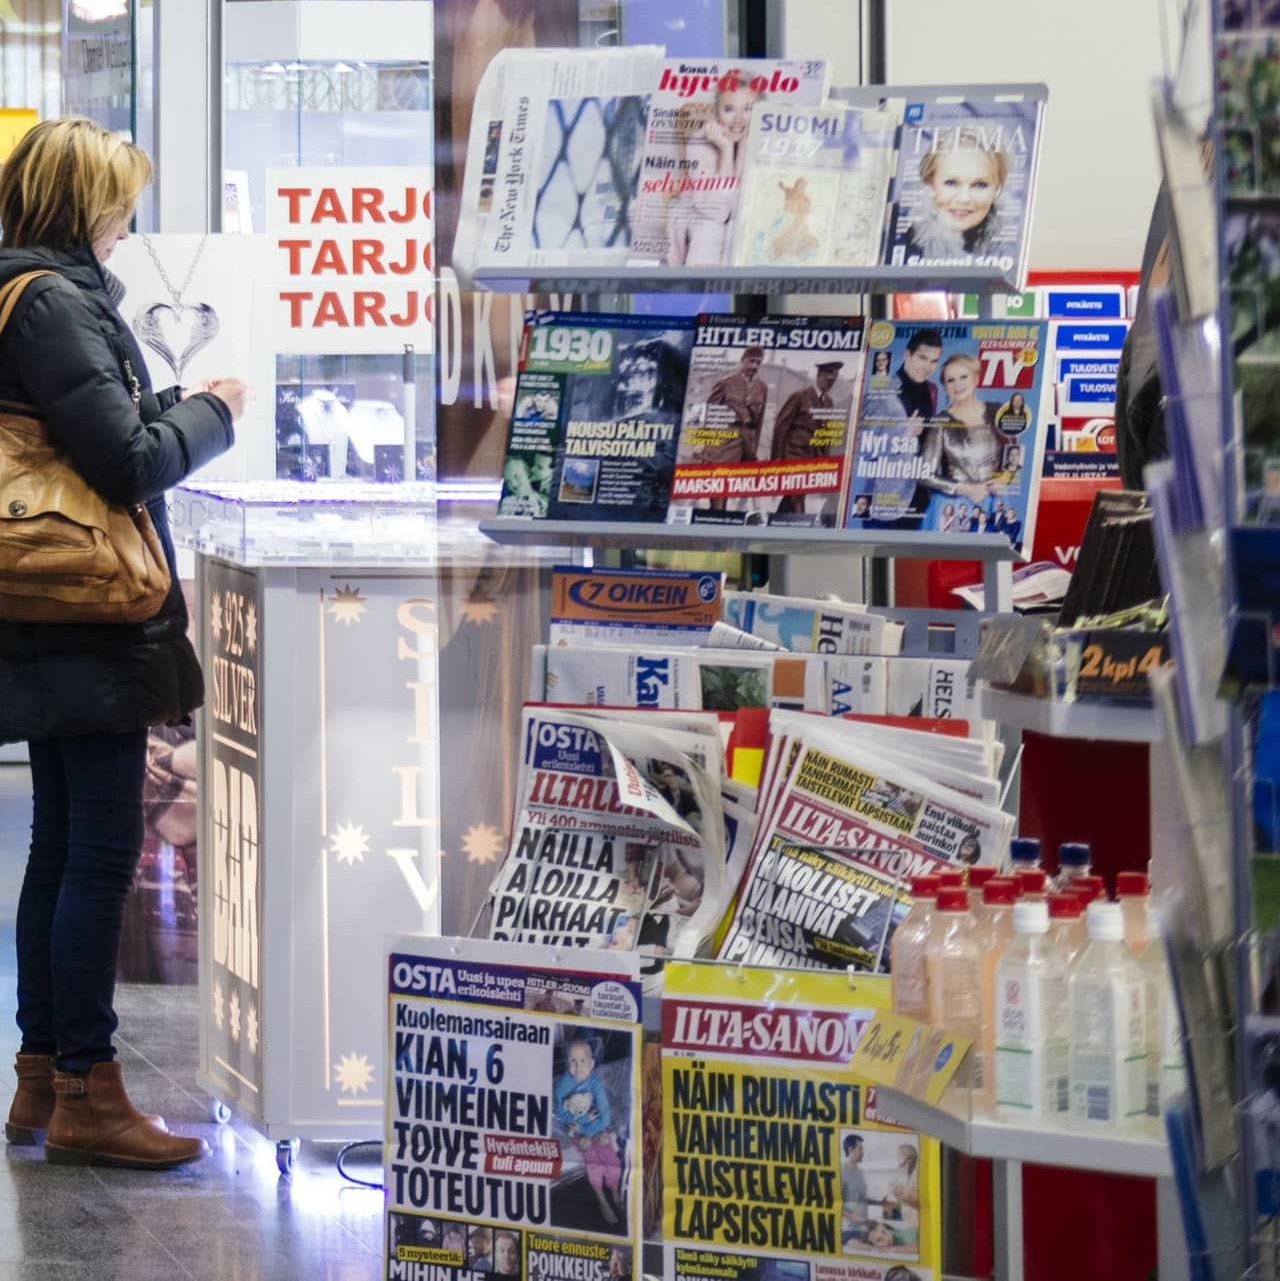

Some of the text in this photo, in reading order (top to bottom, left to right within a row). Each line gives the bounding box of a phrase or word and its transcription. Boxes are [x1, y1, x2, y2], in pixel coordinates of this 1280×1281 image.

[659, 67, 800, 98] hyvä olo
[760, 112, 838, 137] SUOMI
[494, 221, 516, 253] The
[509, 96, 531, 144] Times
[645, 155, 675, 169] Näin
[278, 188, 433, 224] TARJ
[278, 238, 433, 276] TARJ
[279, 291, 433, 328] TARJ
[530, 327, 614, 362] 1930
[695, 326, 775, 347] HITLER
[788, 329, 861, 350] SUOMI
[980, 350, 1028, 387] TV
[1079, 383, 1117, 393] TULOSV
[566, 420, 617, 441] NOUSU
[618, 421, 674, 441] PÄÄTTYI
[860, 431, 919, 457] Nyt saa
[1097, 435, 1116, 445] LOT
[565, 438, 656, 458] TALVISOTAAN
[673, 477, 725, 495] MARSKI
[727, 474, 779, 493] TAKLASI
[781, 471, 838, 491] HITLERIN
[857, 457, 938, 480] hullutella!
[608, 582, 689, 606] OIKEIN
[224, 591, 245, 658] 925
[1080, 644, 1104, 677] 2
[213, 654, 257, 735] SILVER
[539, 722, 601, 753] OSTA
[801, 762, 862, 798] VANHEMMAT
[804, 750, 875, 789] NÄIN RUMASTI
[550, 812, 578, 828] 400
[795, 774, 915, 835] TAISTELEVAT LAPSISTAAN
[924, 804, 947, 822] Ensi
[918, 819, 957, 842] paistaa
[515, 826, 616, 874] NÄILLÄ
[505, 863, 621, 905] ALOILLA
[496, 895, 627, 935] PARHAAT
[393, 962, 457, 995] OSTA
[457, 969, 525, 990] Uusi ja upea
[457, 983, 522, 1003] erikoislehti
[562, 983, 591, 997] SUOMI
[395, 1003, 551, 1046] Kuolemansairaan
[672, 1006, 870, 1057] ILTA-SANOM
[395, 1031, 505, 1085] KIAN, 6
[395, 1076, 550, 1137] VIIMEINEN
[672, 1061, 861, 1126] NÄIN RUMASTI
[393, 1120, 480, 1170] TOIVE
[486, 1136, 559, 1163] Hyväntekijä
[672, 1112, 835, 1168] VANHEMMAT
[492, 1153, 554, 1176] tuli apuun
[392, 1164, 551, 1225] TOTEUTUU
[672, 1155, 837, 1210] TAISTELEVAT
[674, 1198, 837, 1254] LAPSISTAAN
[528, 1233, 610, 1260] Tuore ennuste:
